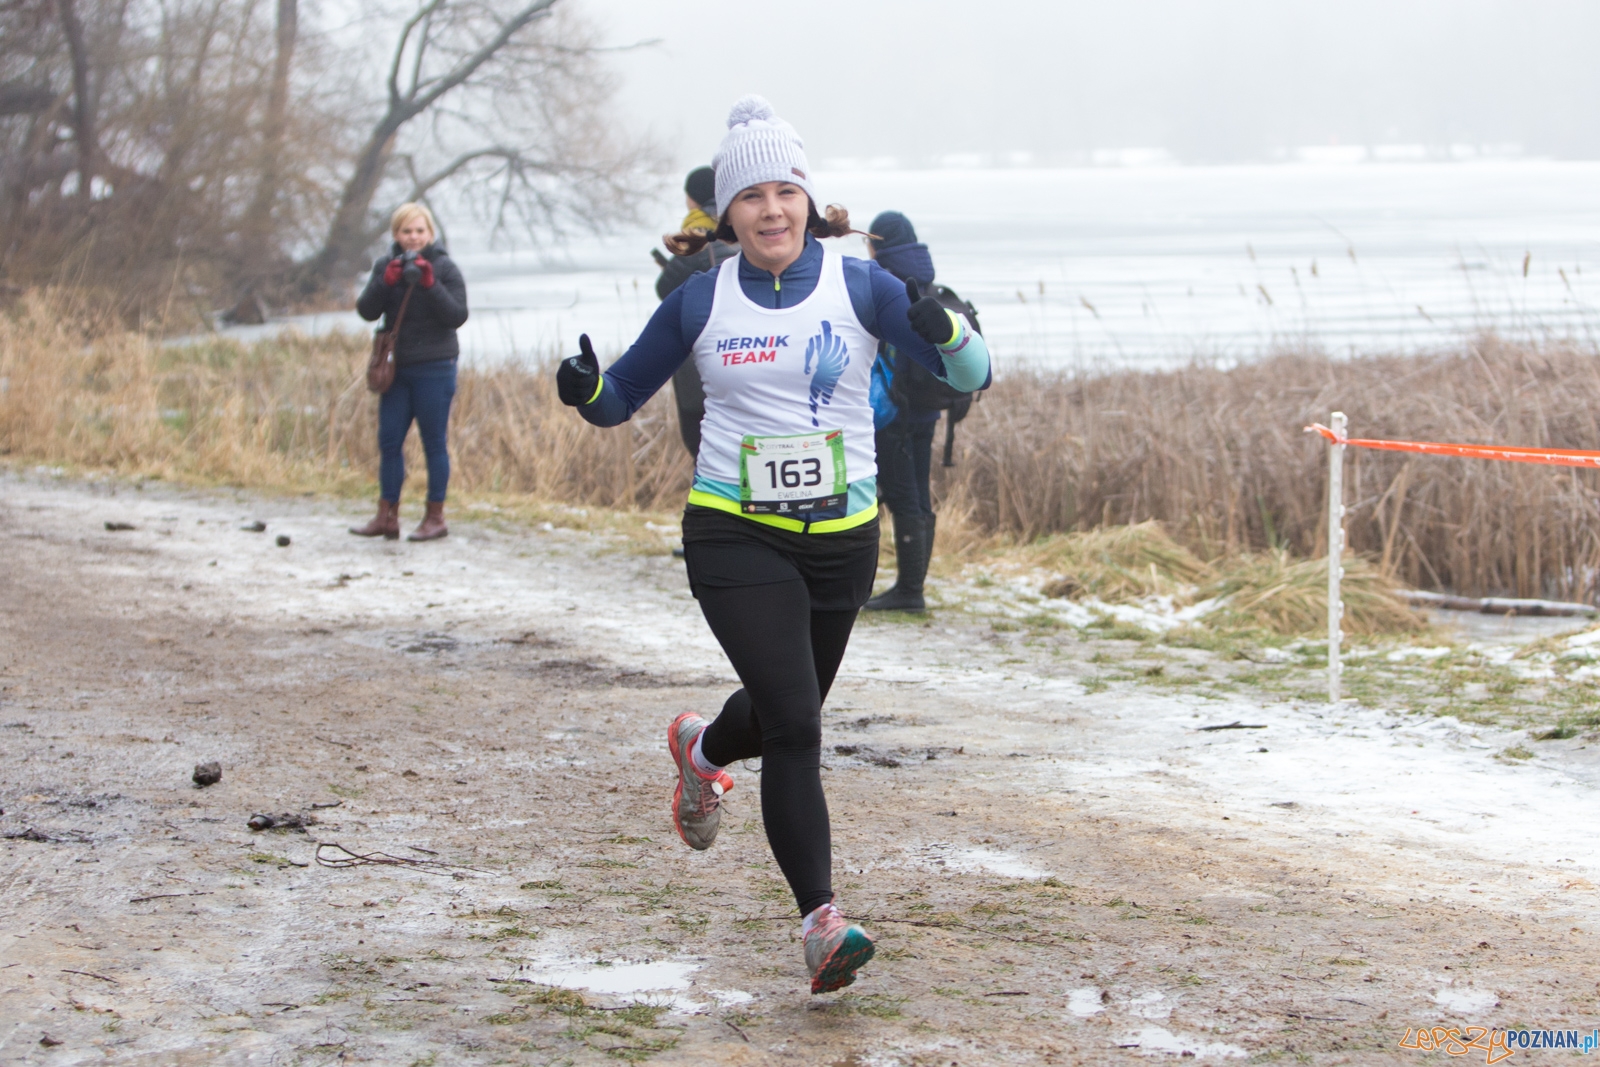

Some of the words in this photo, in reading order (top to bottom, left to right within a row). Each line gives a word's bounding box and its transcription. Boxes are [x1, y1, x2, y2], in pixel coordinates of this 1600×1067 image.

[716, 335, 790, 353] HERNIK
[721, 350, 777, 366] TEAM
[765, 457, 822, 489] 163
[777, 490, 813, 500] EWELINA
